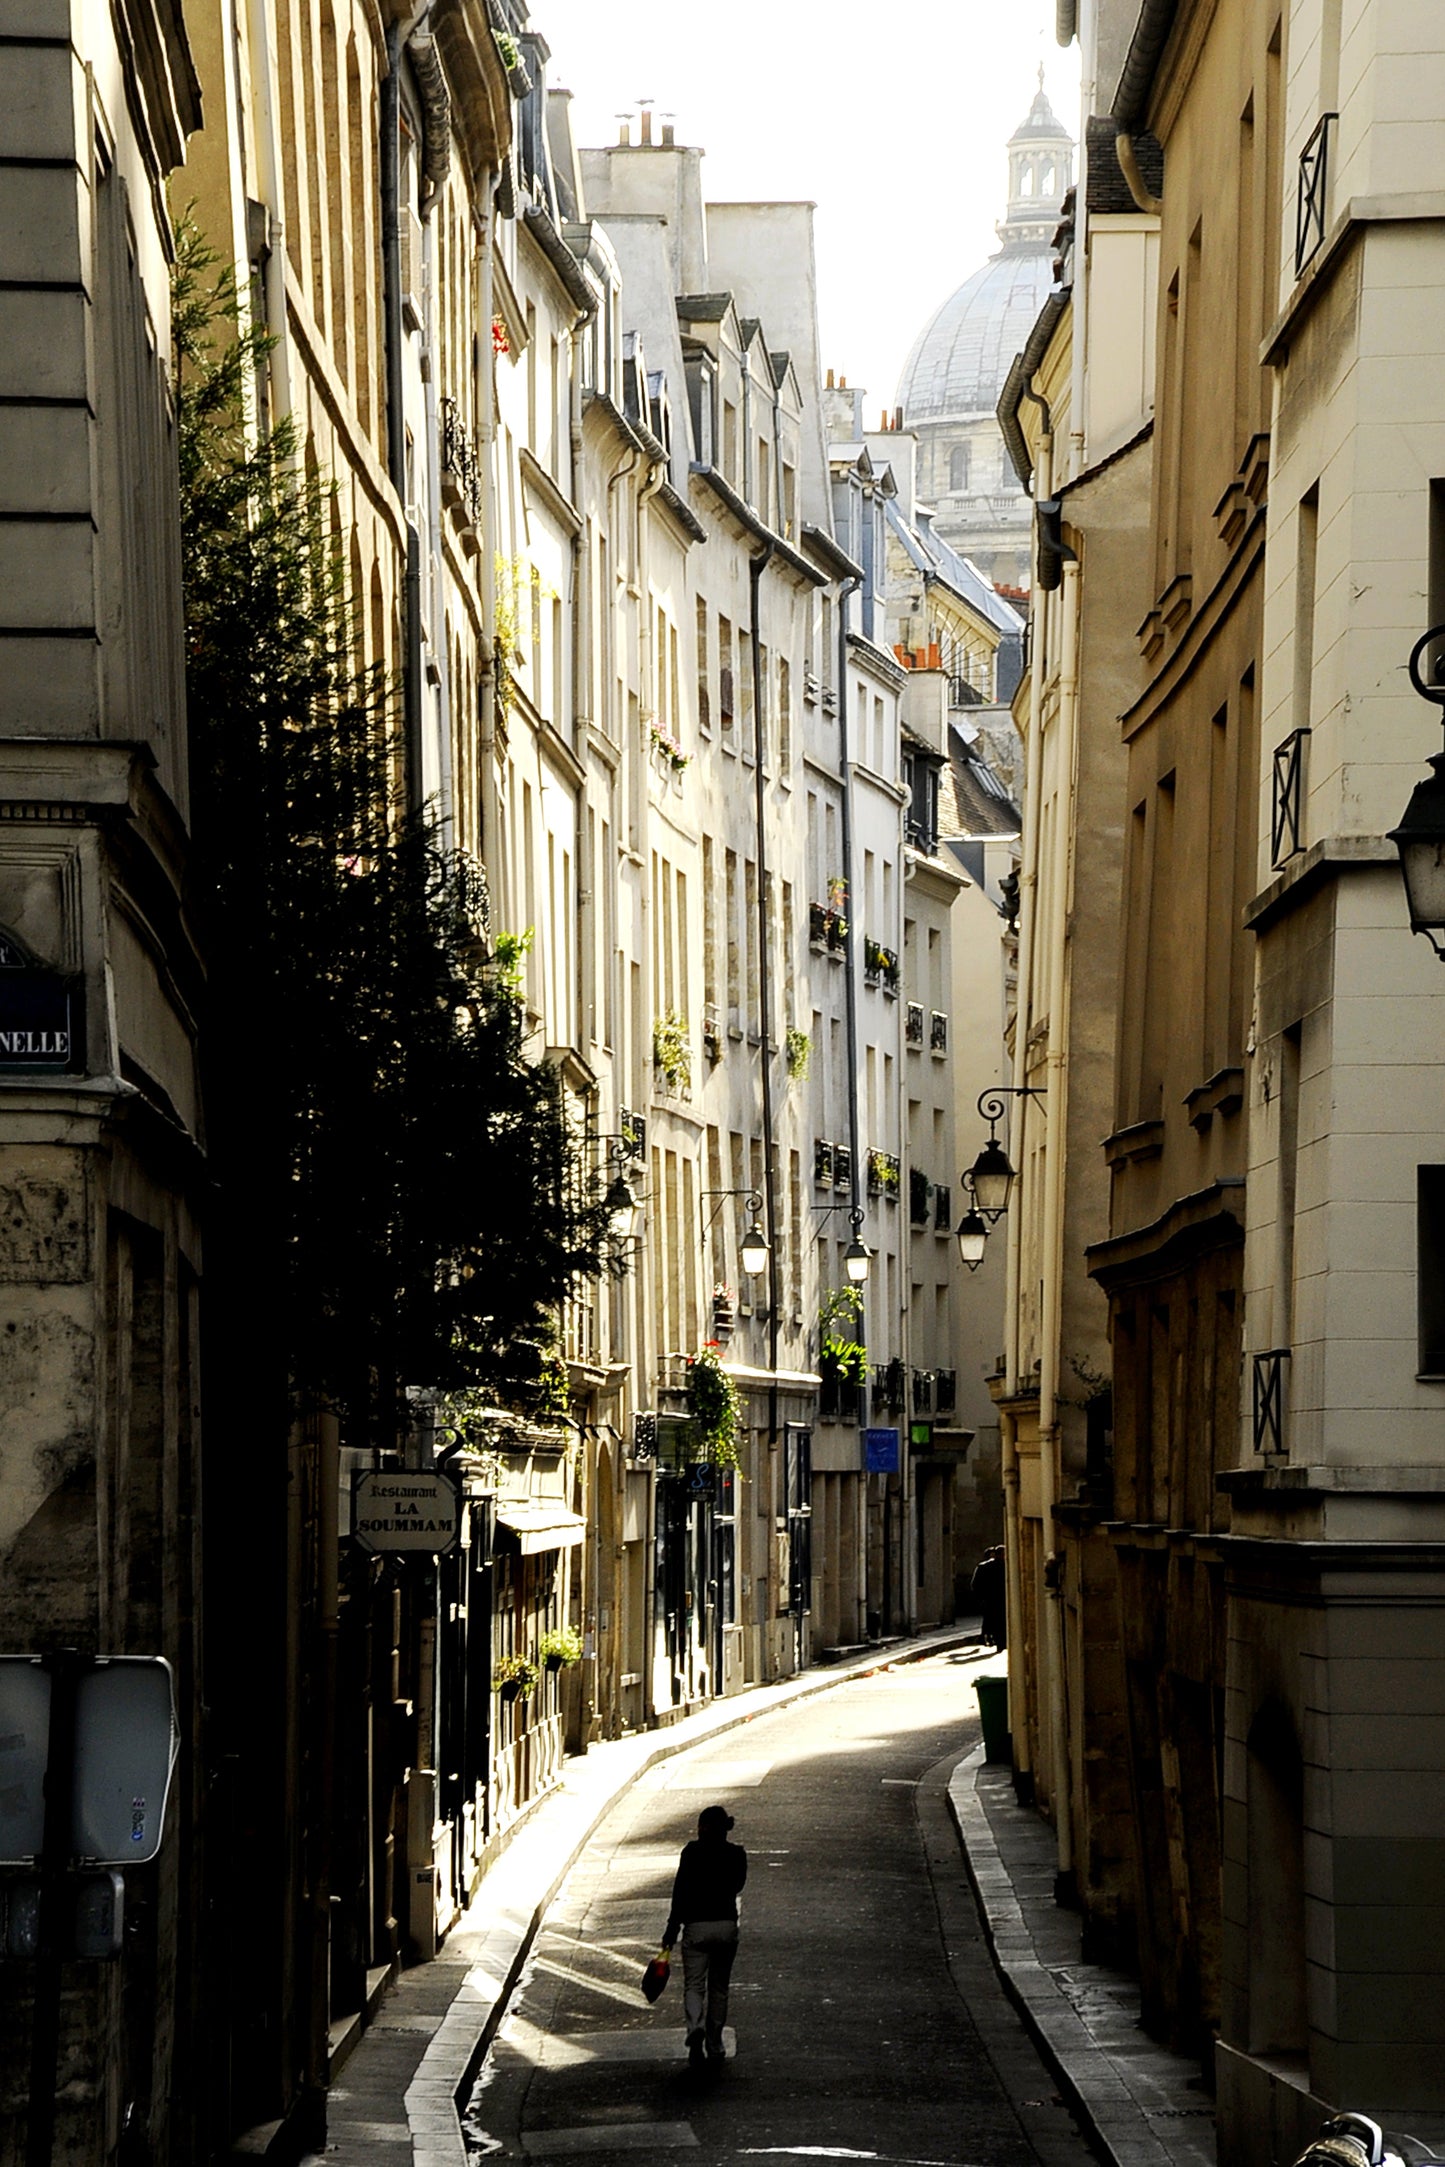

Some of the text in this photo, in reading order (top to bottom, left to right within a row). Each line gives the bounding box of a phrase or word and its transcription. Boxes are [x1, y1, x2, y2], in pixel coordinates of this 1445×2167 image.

[369, 1485, 438, 1498] Restaurant
[394, 1502, 419, 1515] LA
[359, 1519, 453, 1532] SOUMMAM
